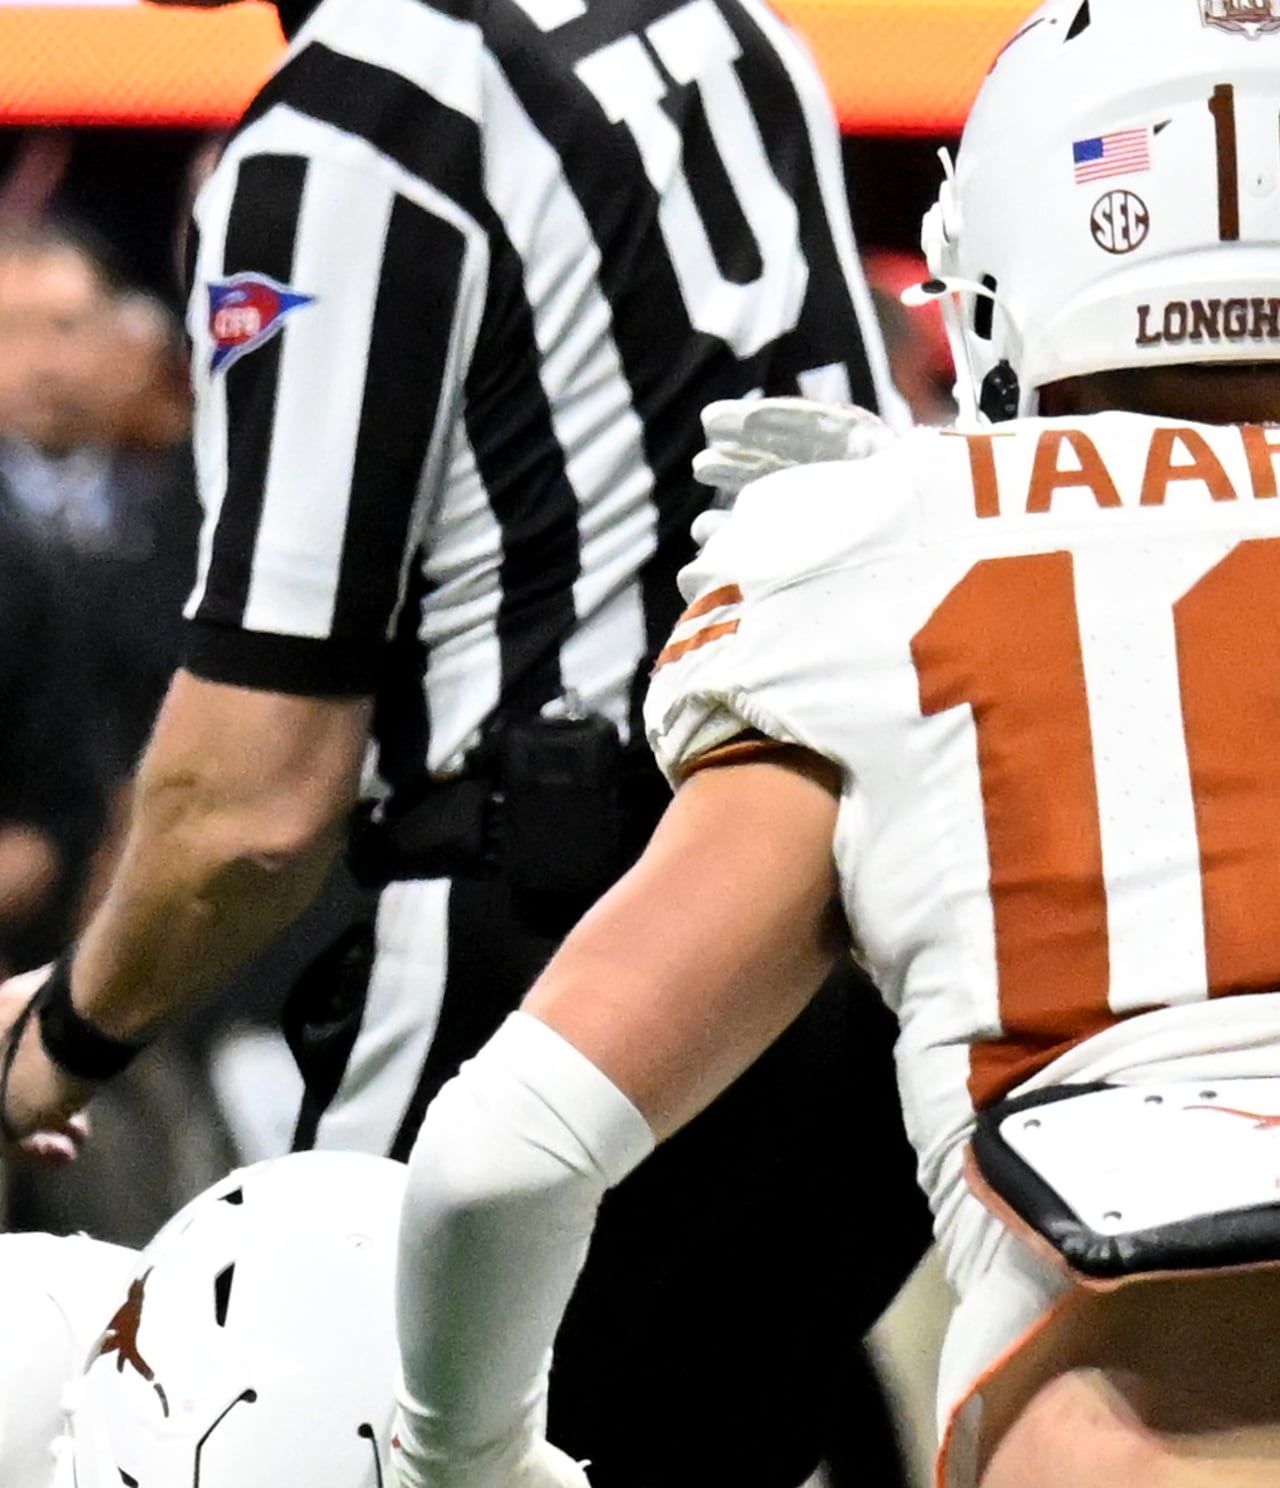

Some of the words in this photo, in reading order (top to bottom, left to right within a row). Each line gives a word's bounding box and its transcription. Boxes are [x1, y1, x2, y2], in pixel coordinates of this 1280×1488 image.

[573, 0, 809, 360] U
[1090, 189, 1150, 254] SEC
[1136, 298, 1280, 345] LONGH
